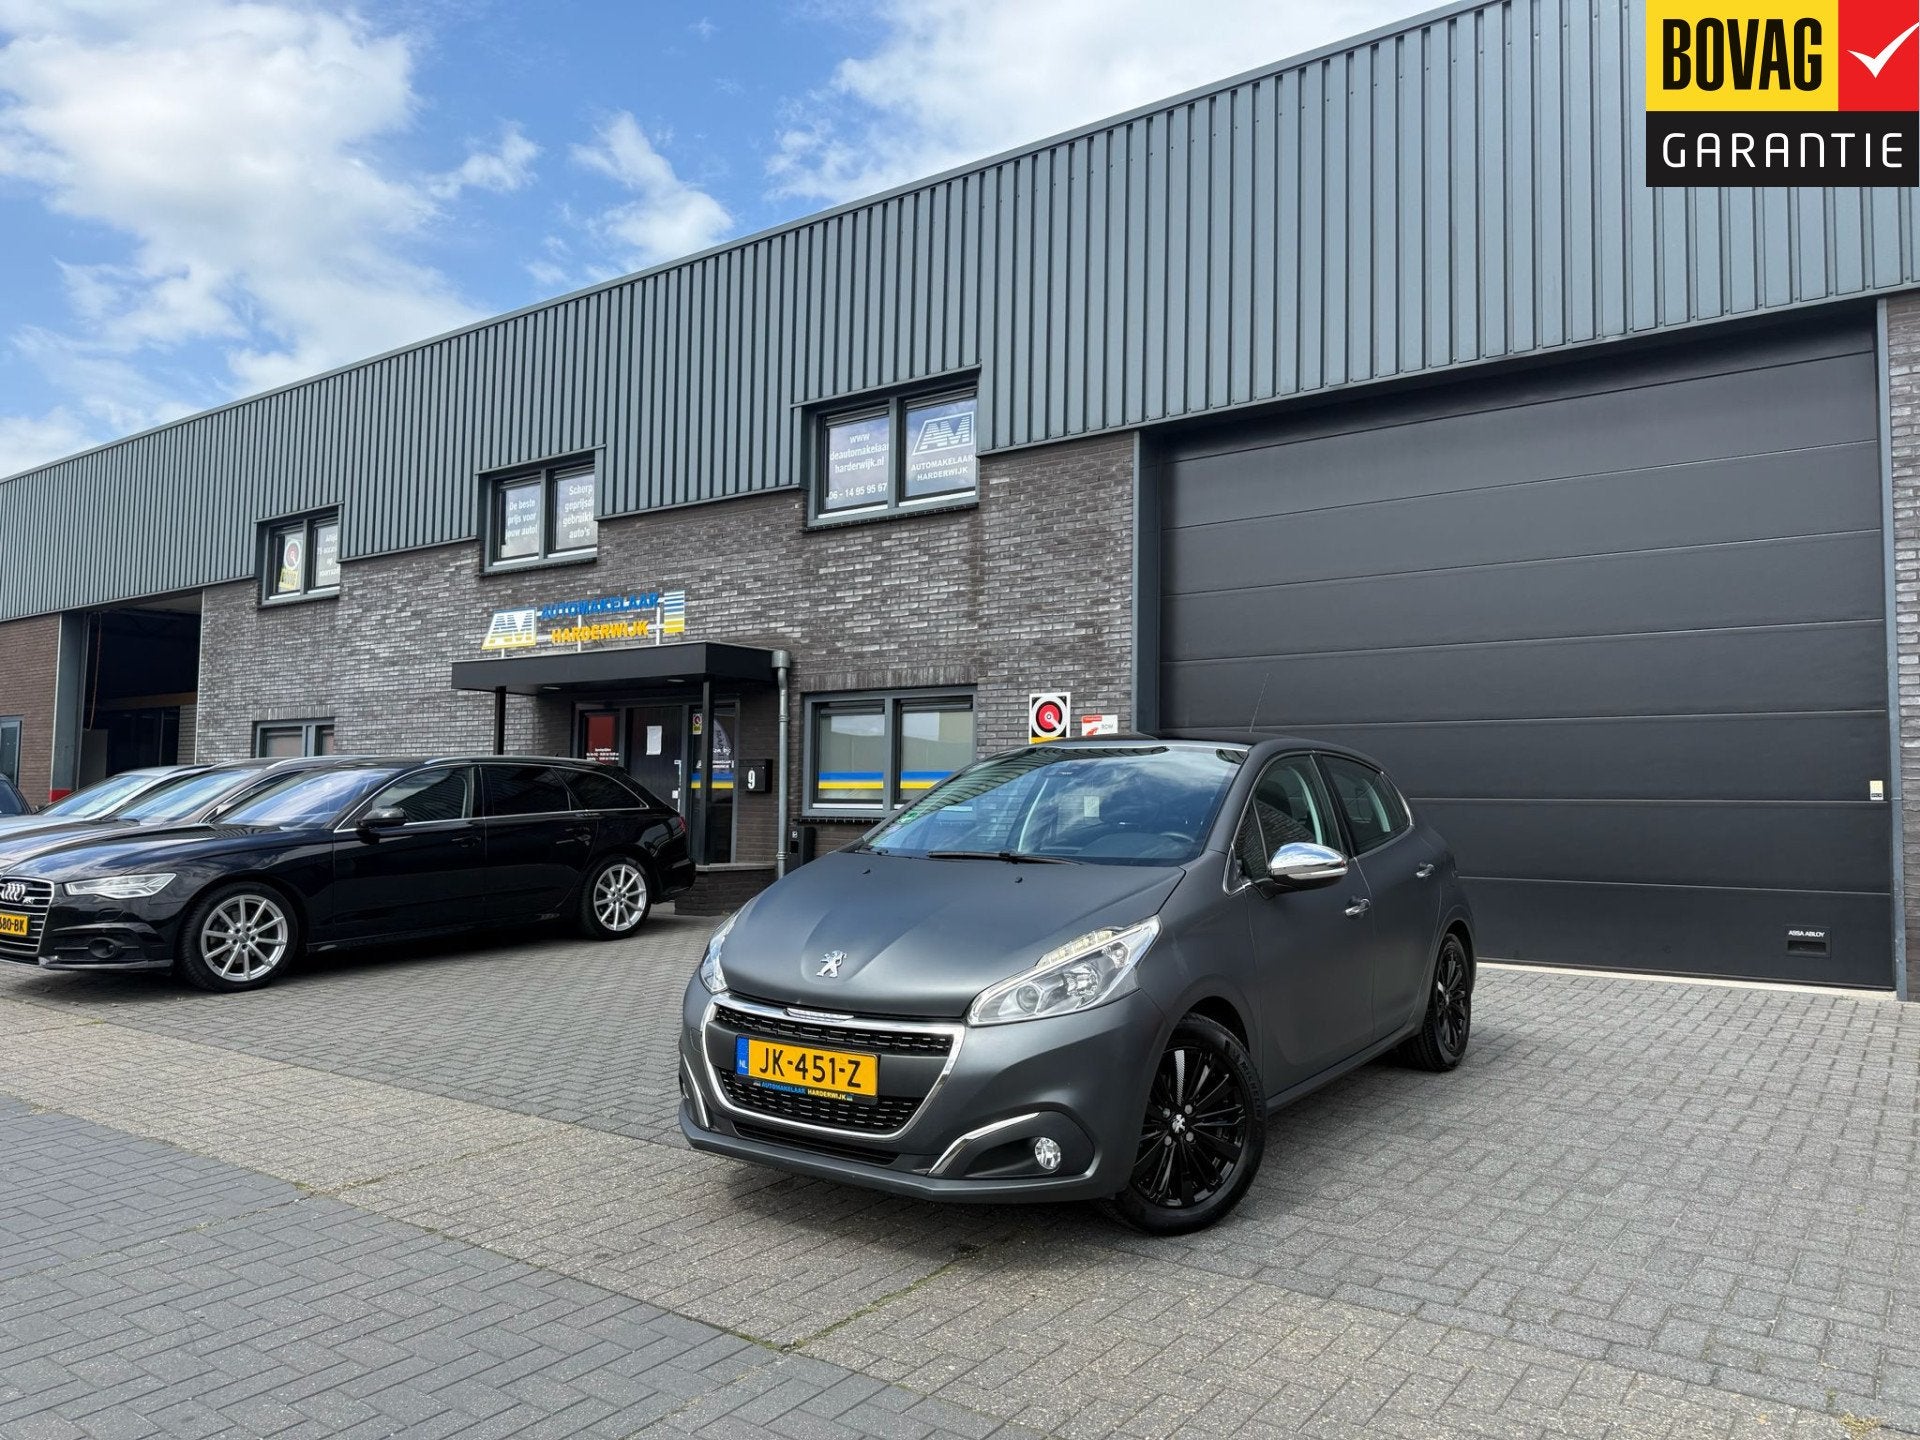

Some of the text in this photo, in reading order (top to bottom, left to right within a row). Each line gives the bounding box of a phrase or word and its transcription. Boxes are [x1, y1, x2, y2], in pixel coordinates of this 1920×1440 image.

[849, 433, 870, 444] www
[834, 456, 885, 474] harderwijk.nl
[910, 454, 974, 471] AUTOMAKELAAR
[917, 466, 969, 481] HARDERWIJK
[541, 592, 659, 620] AUTOMAKELAAR
[551, 620, 649, 643] HARDERWIJK
[747, 769, 756, 790] 9
[740, 1059, 748, 1069] NL
[759, 1048, 862, 1089] JK-451-Z
[761, 1081, 847, 1101] AUTOMAKELAAR HARDERWIJK
